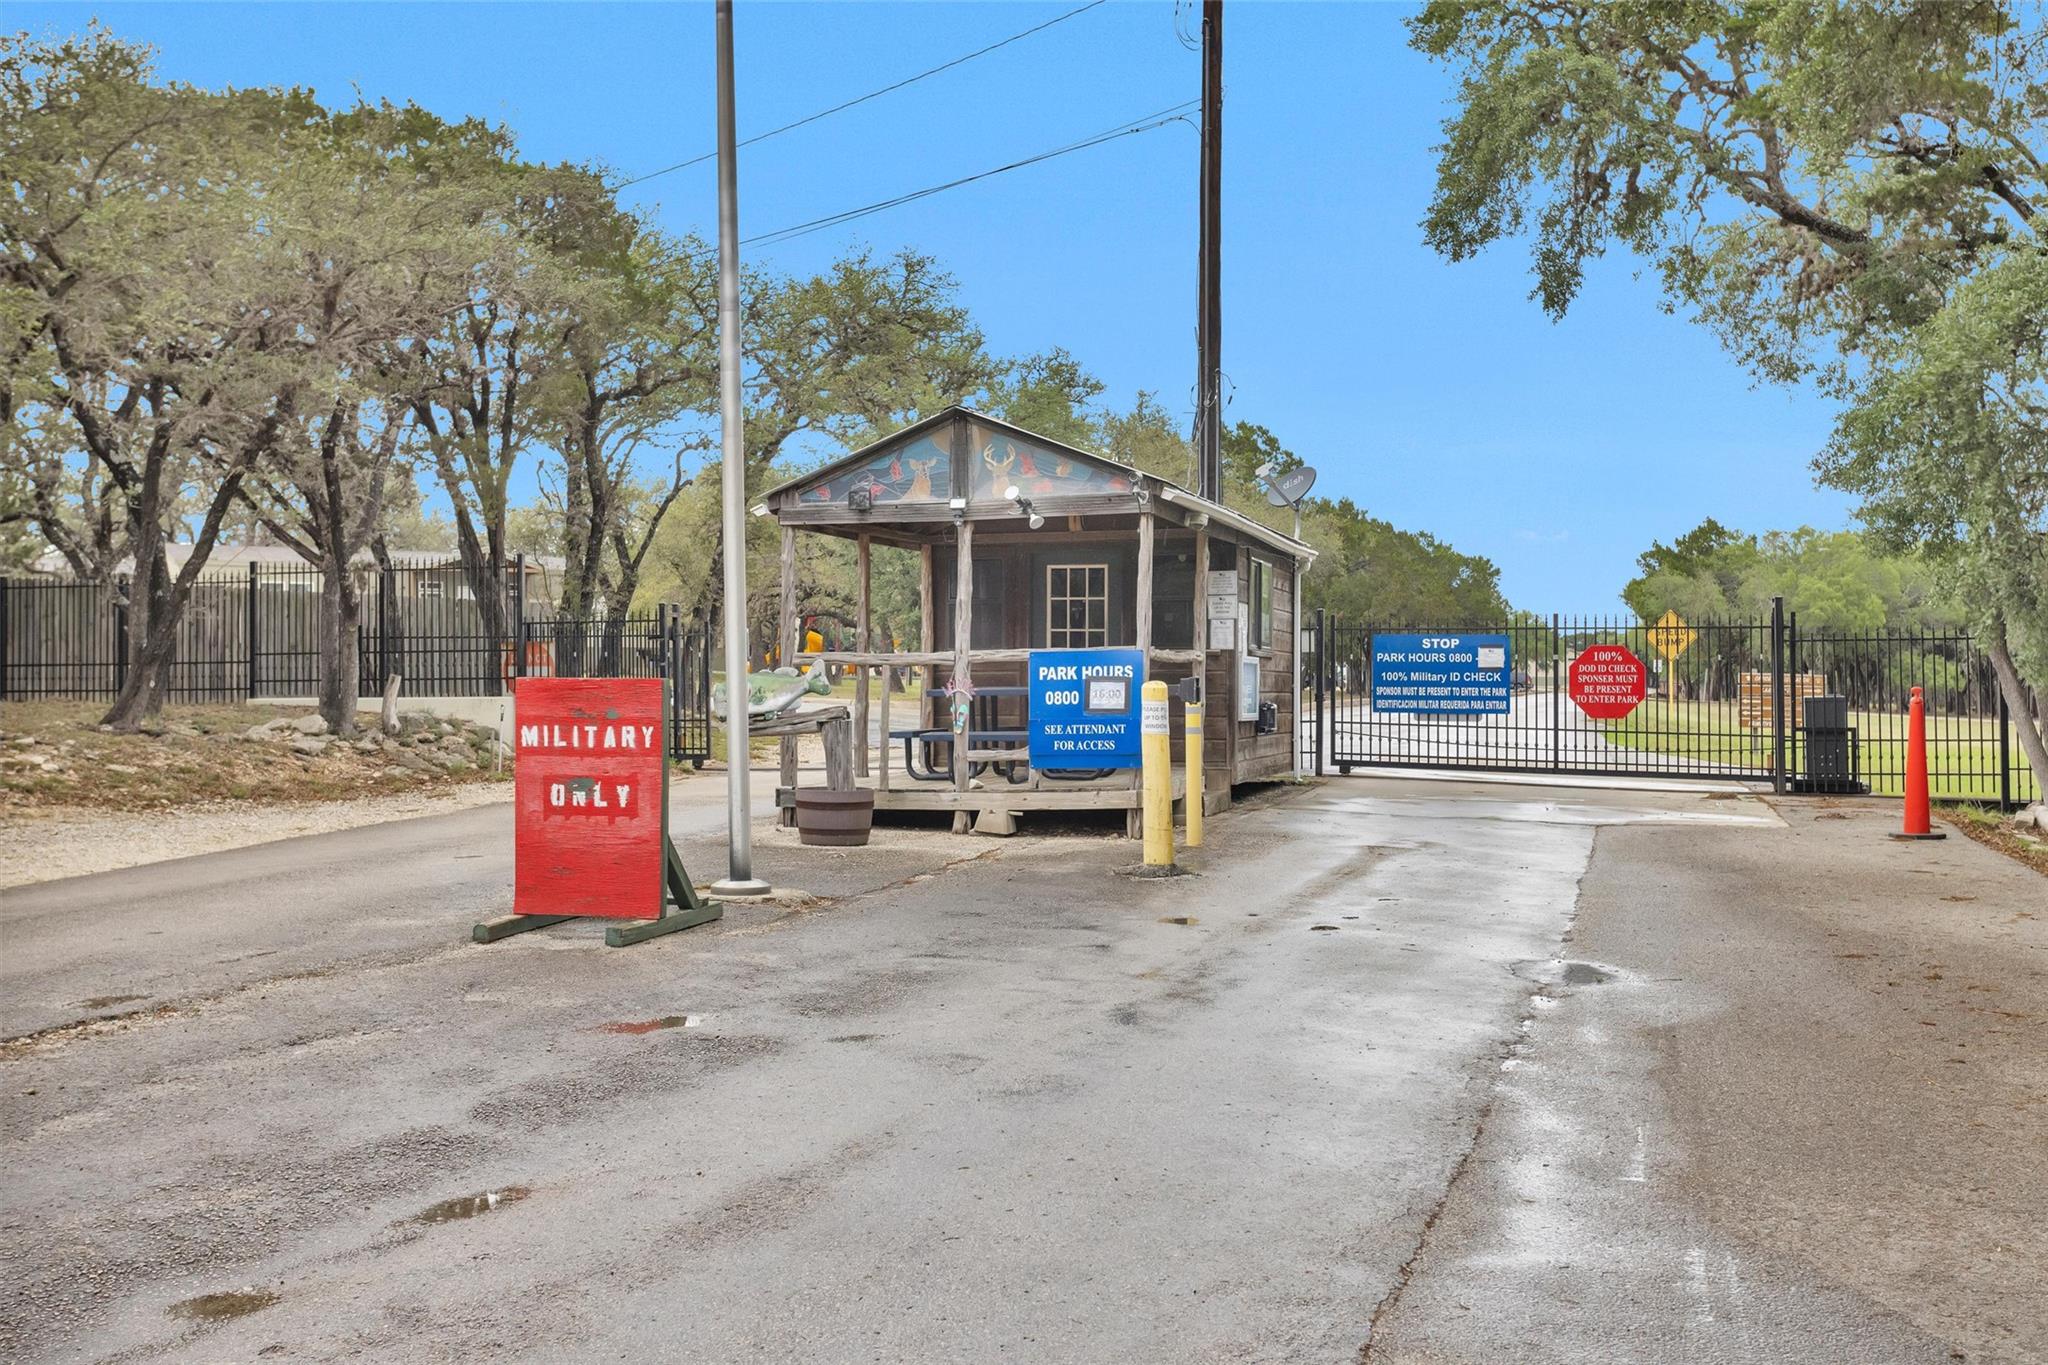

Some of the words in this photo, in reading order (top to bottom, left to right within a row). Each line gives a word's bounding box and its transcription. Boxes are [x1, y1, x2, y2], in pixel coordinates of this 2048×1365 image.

[1283, 475, 1304, 490] dish
[1656, 627, 1687, 636] SPEED
[1422, 638, 1460, 649] STOP
[1656, 638, 1685, 647] BUMP
[1376, 653, 1406, 663] PARK
[1408, 653, 1446, 663] HOURS
[1448, 653, 1473, 663] 0800
[1593, 651, 1623, 661] 100%
[1039, 666, 1078, 681] PARK
[1081, 664, 1134, 680] HOURS
[1579, 664, 1597, 673] DOD
[1598, 664, 1607, 673] ID
[1608, 664, 1637, 673] CHECK
[1381, 671, 1408, 681] 100%
[1410, 671, 1447, 683] Military
[1449, 672, 1461, 681] ID
[1463, 672, 1502, 682] CHECK
[1577, 674, 1614, 683] SPONSER
[1615, 674, 1638, 683] MUST
[1376, 686, 1402, 696] SPONSOR
[1402, 686, 1418, 696] MUST
[1418, 686, 1426, 696] BE
[1427, 686, 1451, 696] PRESENT
[1452, 687, 1460, 696] TO
[1461, 687, 1479, 696] ENTER
[1480, 687, 1491, 696] THE
[1492, 687, 1507, 696] PARK
[1584, 685, 1595, 694] BE
[1596, 685, 1632, 694] PRESENT
[1045, 690, 1080, 706] 0800
[1576, 694, 1587, 703] TO
[1588, 694, 1615, 704] ENTER
[1617, 695, 1639, 704] PARK
[1418, 699, 1440, 709] MILITAR
[1470, 700, 1484, 710] PARA
[1485, 700, 1507, 710] ENTRAR
[1044, 724, 1064, 735] SEE
[1065, 724, 1126, 735] ATTENDANT
[520, 724, 654, 749] MILITARY
[1054, 740, 1074, 751] FOR
[1076, 740, 1116, 751] ACCESS
[550, 780, 630, 808] ONLY
